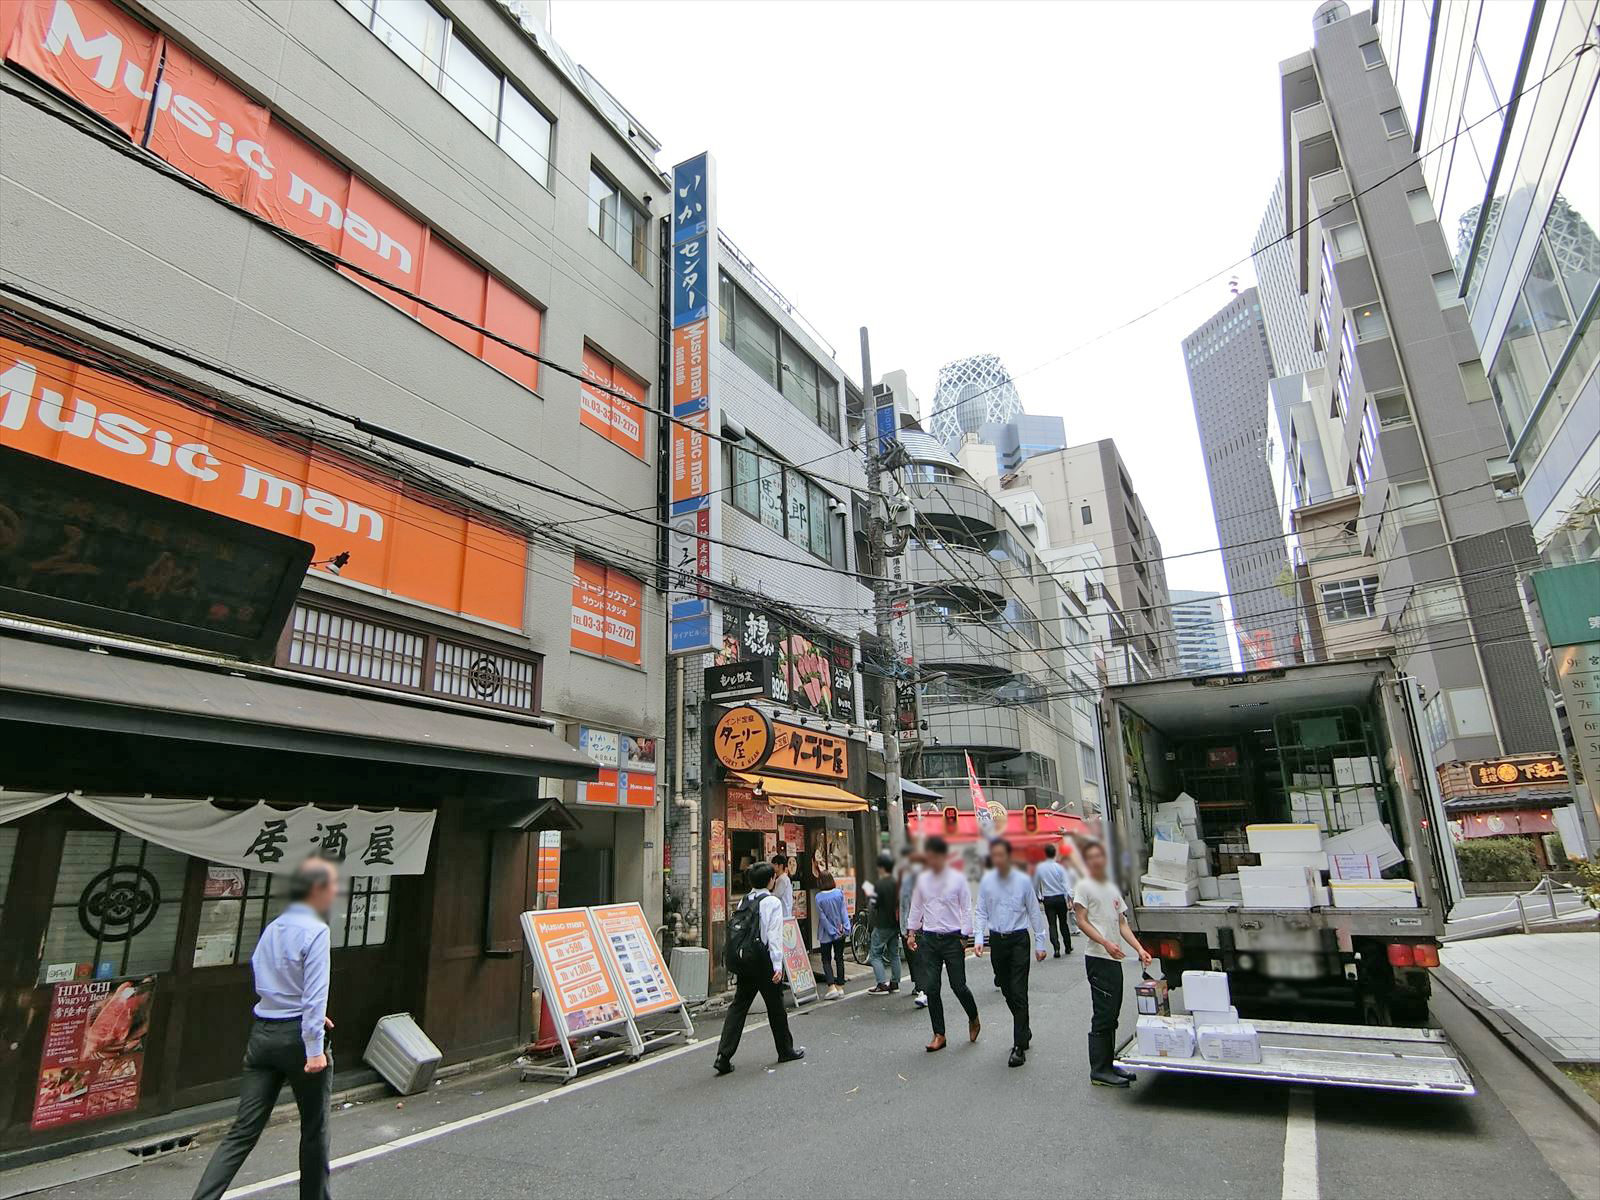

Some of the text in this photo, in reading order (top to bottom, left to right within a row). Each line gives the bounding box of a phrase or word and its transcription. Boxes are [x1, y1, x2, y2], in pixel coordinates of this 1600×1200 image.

[41, 0, 412, 274] Music man
[696, 221, 706, 234] 5
[678, 175, 702, 309] いか センター
[690, 367, 702, 398] man
[699, 396, 707, 409] 3
[690, 461, 703, 494] man
[239, 464, 384, 542] man
[1572, 679, 1587, 689] 8F
[1577, 699, 1592, 710] 7F
[903, 731, 915, 739] 2F
[733, 741, 745, 760] 屋
[789, 731, 844, 773] ターリー屋
[243, 819, 395, 866] 居酒屋
[58, 981, 111, 997] HITACHI
